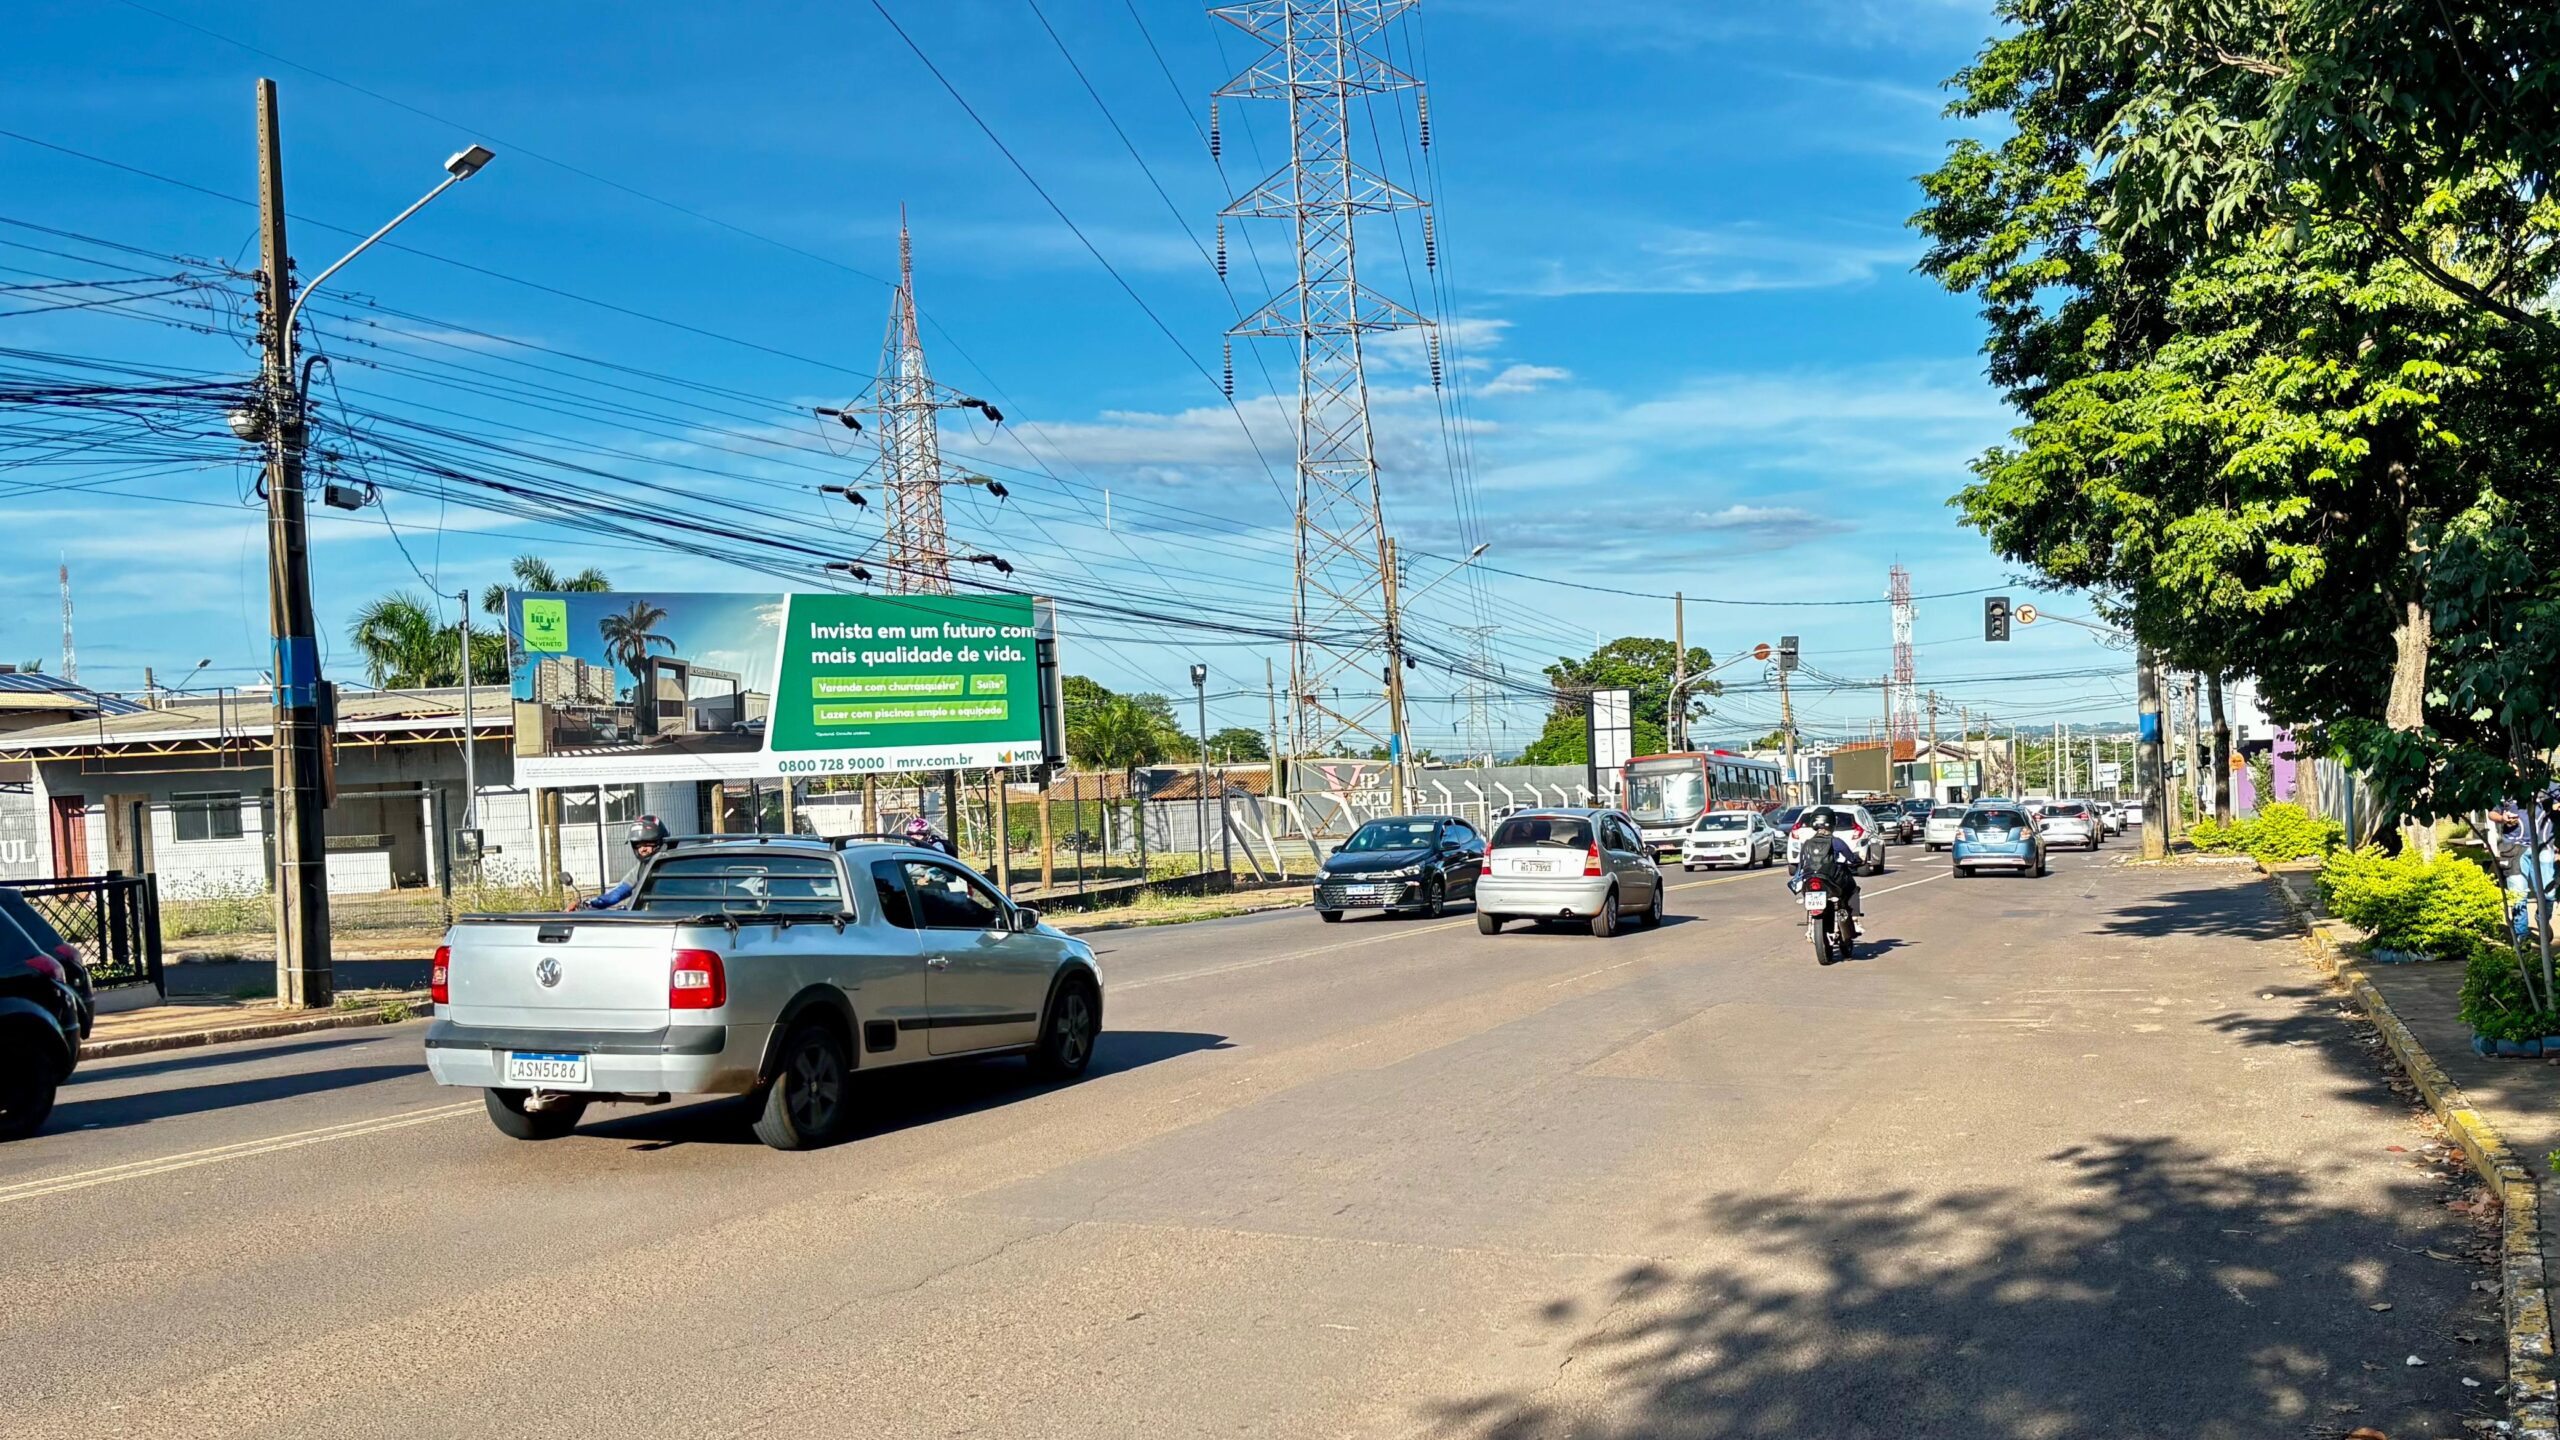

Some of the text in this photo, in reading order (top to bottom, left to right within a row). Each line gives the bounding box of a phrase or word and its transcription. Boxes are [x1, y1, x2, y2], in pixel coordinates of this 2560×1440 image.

[810, 621, 1037, 639] Invista em um futuro com
[811, 645, 1026, 667] mais qualidade de vida.
[819, 683, 863, 693] Varanda
[864, 684, 887, 692] com
[820, 711, 849, 719] Lazer
[850, 711, 873, 719] com
[874, 709, 915, 719] piscinas
[896, 752, 975, 769] mrv.com.br
[1014, 750, 1042, 761] MRV
[778, 757, 885, 773] 0800 728 9000
[517, 1062, 577, 1079] ASN5C86
